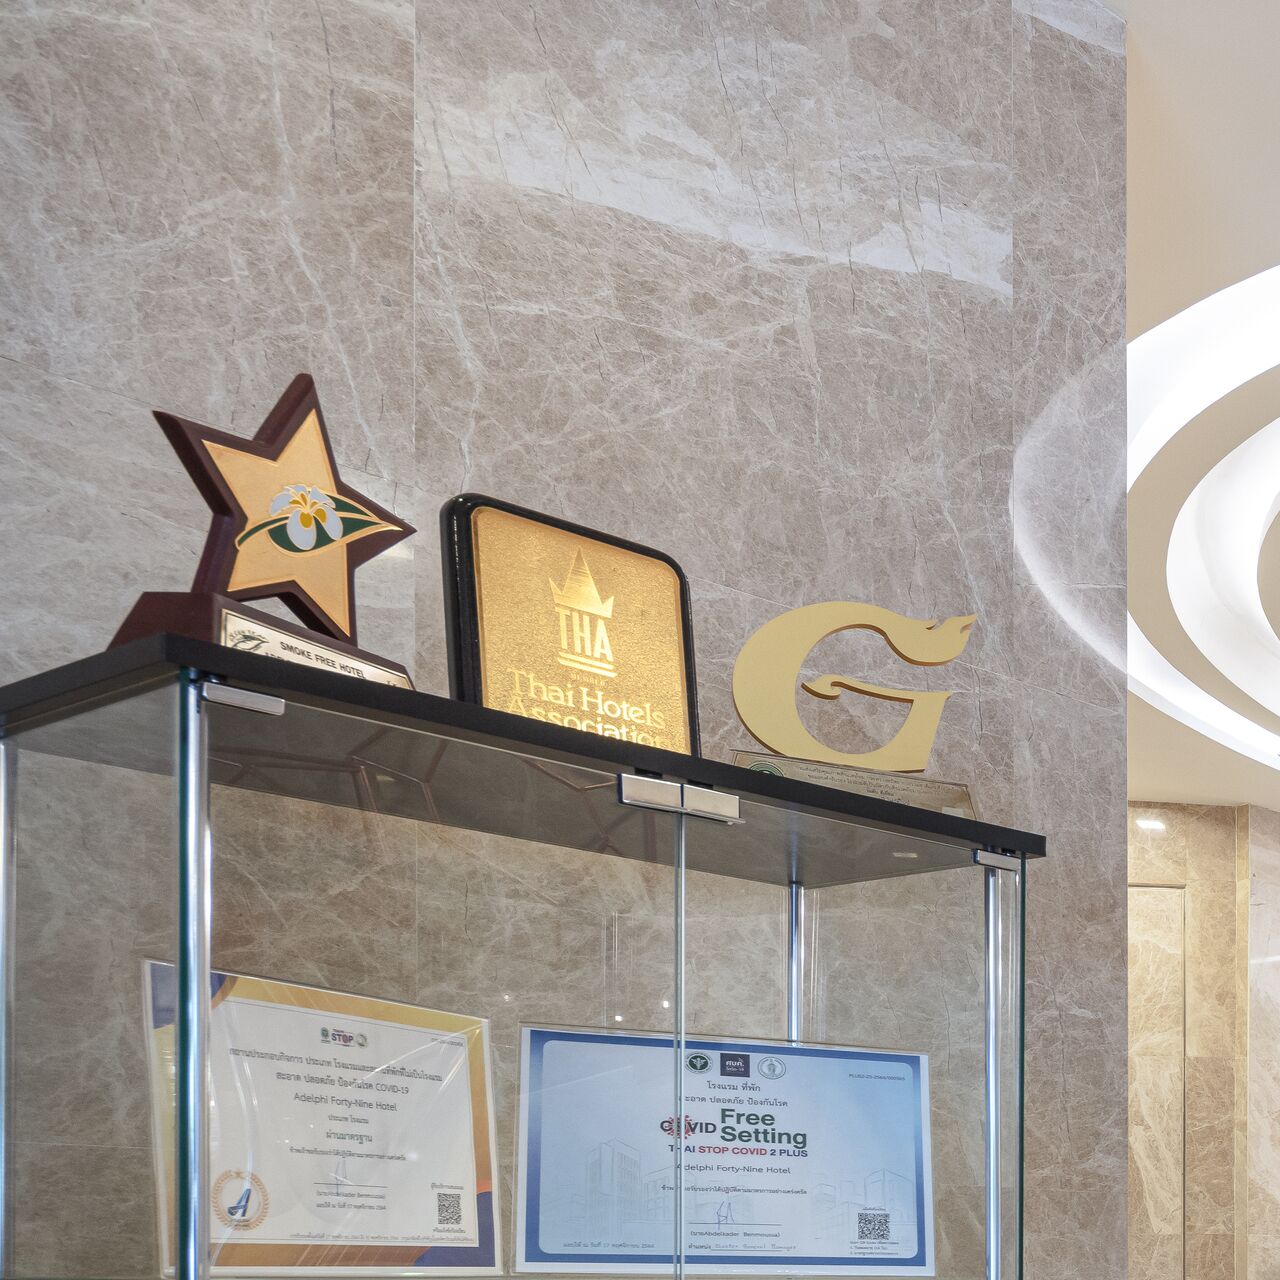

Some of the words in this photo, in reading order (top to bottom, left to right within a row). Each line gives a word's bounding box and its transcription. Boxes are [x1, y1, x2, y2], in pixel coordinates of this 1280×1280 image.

[555, 607, 614, 662] THA
[280, 641, 313, 661] SMOKE
[315, 653, 337, 669] FREE
[340, 663, 367, 680] HOTEL
[507, 668, 575, 707] Thai
[580, 686, 666, 729] Hotels
[707, 1081, 738, 1091] โรงแรม
[741, 1081, 761, 1092] ที่พัก
[294, 1092, 328, 1106] Adelphi
[330, 1095, 374, 1109] Forty-Nine
[375, 1100, 398, 1112] Hotel
[679, 1095, 707, 1103] ะอาด
[709, 1095, 744, 1105] ปลอดภัย
[747, 1097, 788, 1107] ป้องกันโรค
[720, 1108, 775, 1126] Free
[720, 1126, 807, 1149] Setting
[698, 1145, 729, 1154] STOP
[731, 1146, 767, 1156] COVID
[779, 1149, 808, 1158] PLUS
[716, 1165, 763, 1173] Forty-Nine
